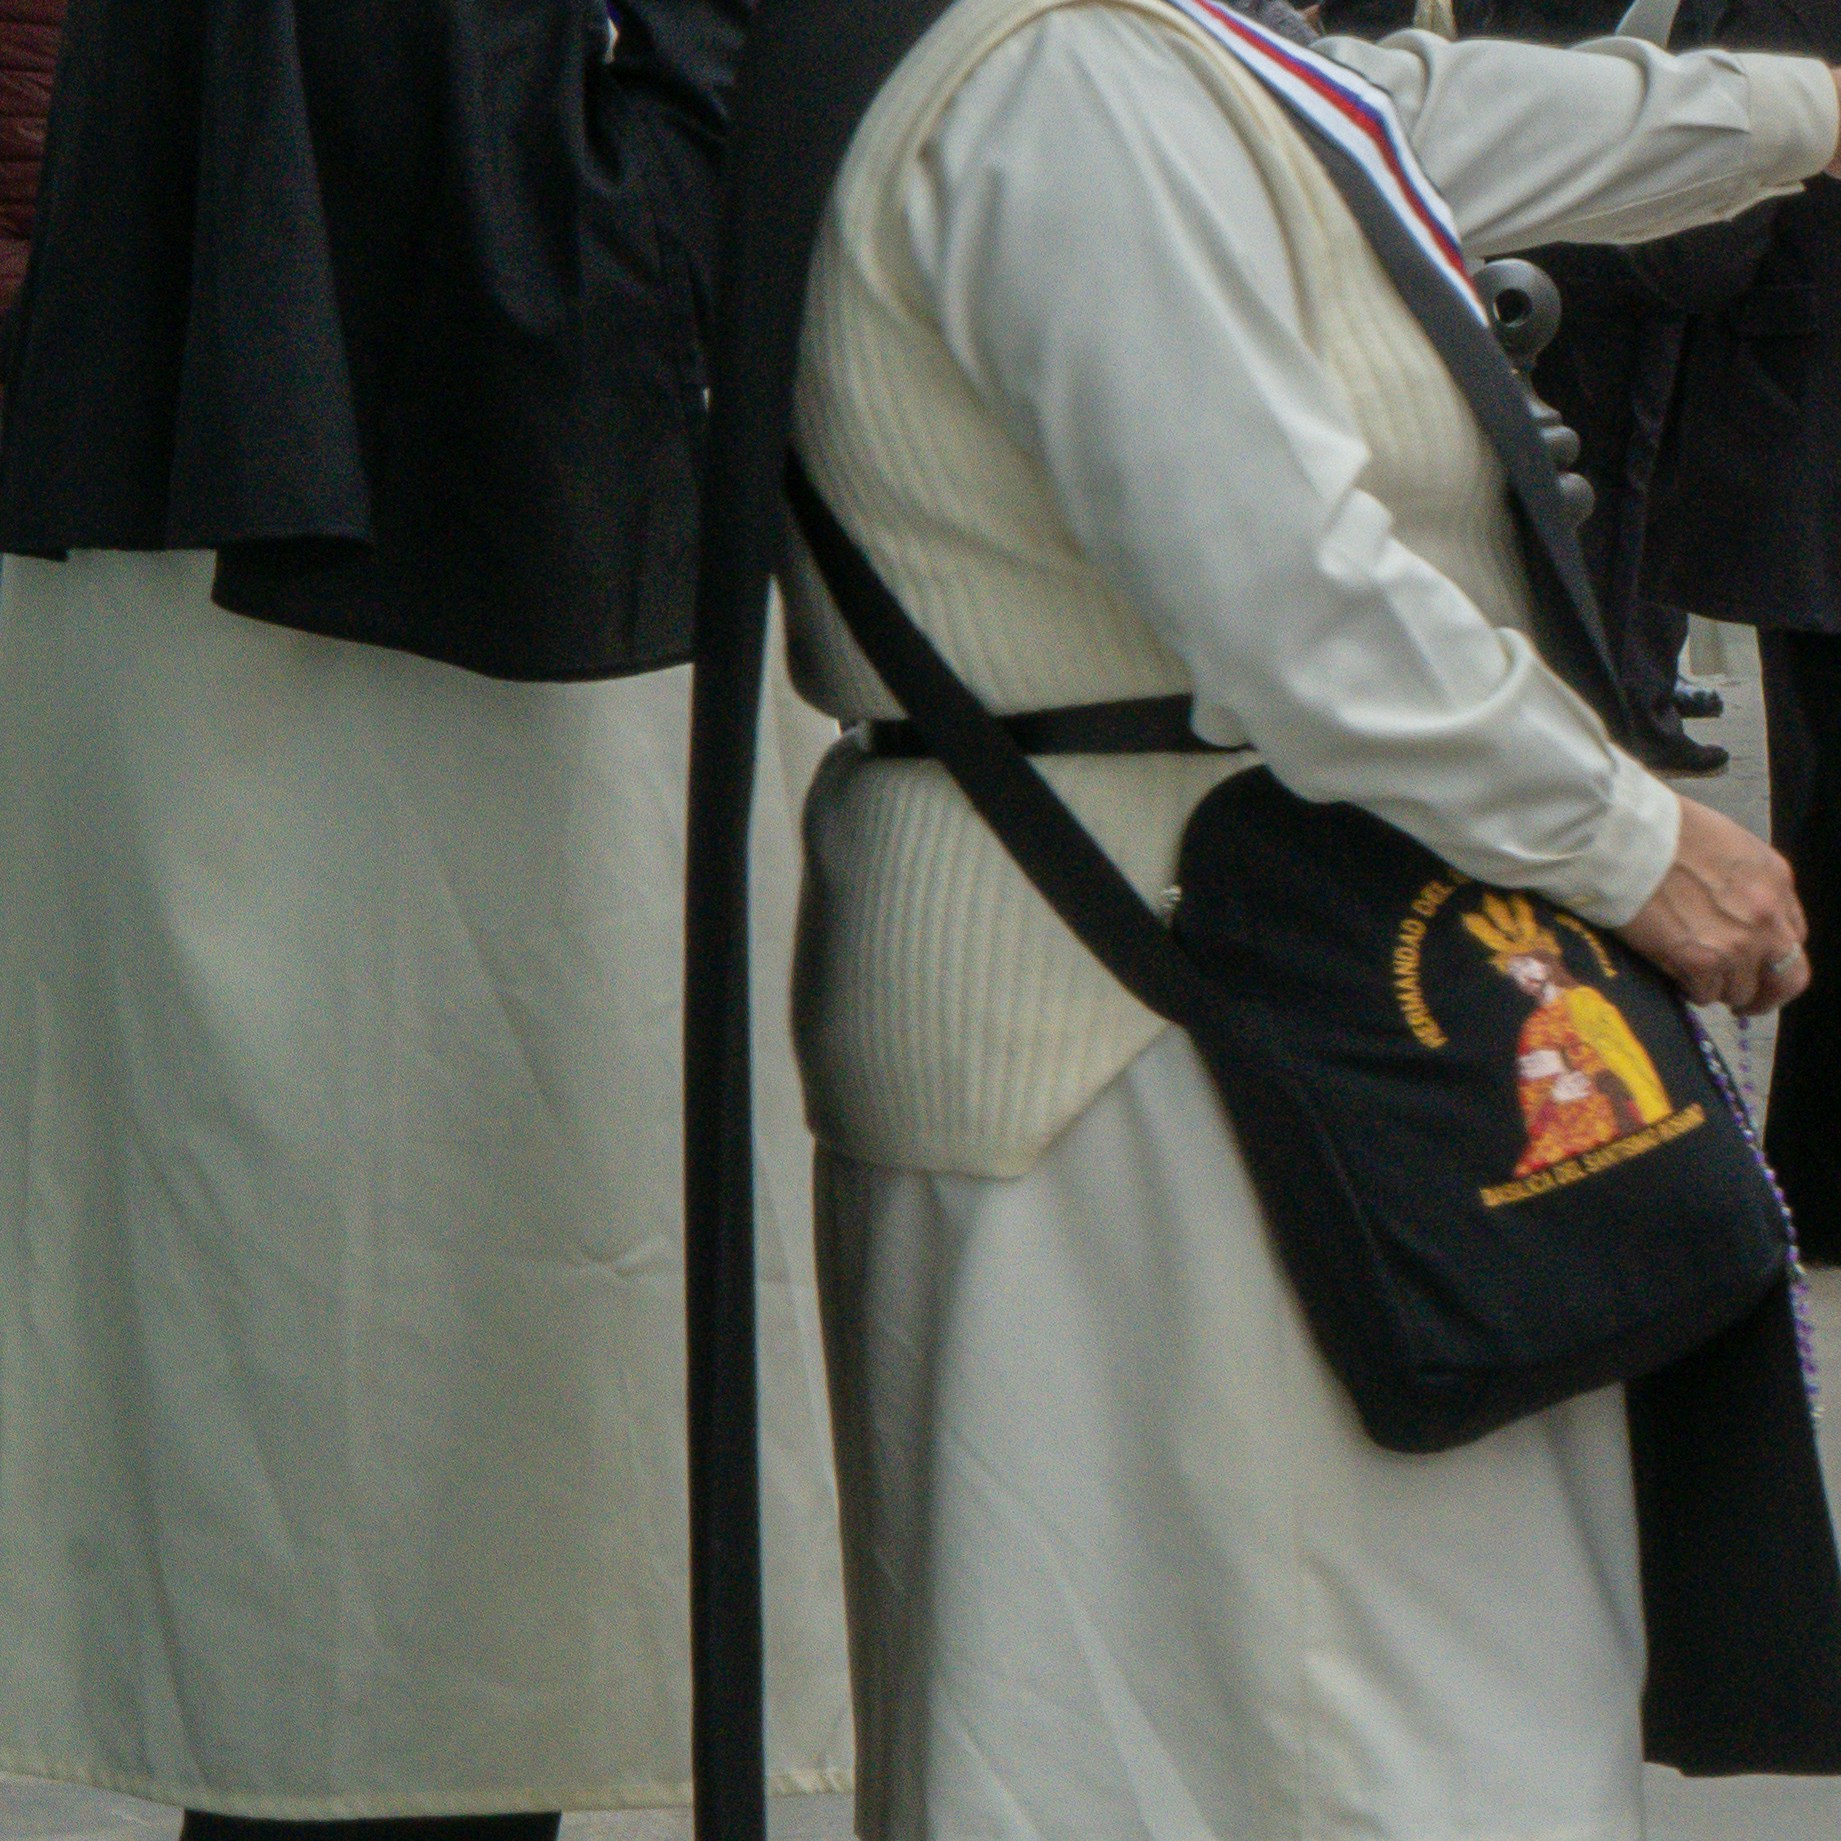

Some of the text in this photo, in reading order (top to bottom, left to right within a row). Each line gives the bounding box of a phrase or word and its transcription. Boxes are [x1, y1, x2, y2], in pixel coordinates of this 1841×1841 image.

[1392, 880, 1457, 1050] HERMANDAD DEL
[1552, 1157, 1588, 1185] DEL
